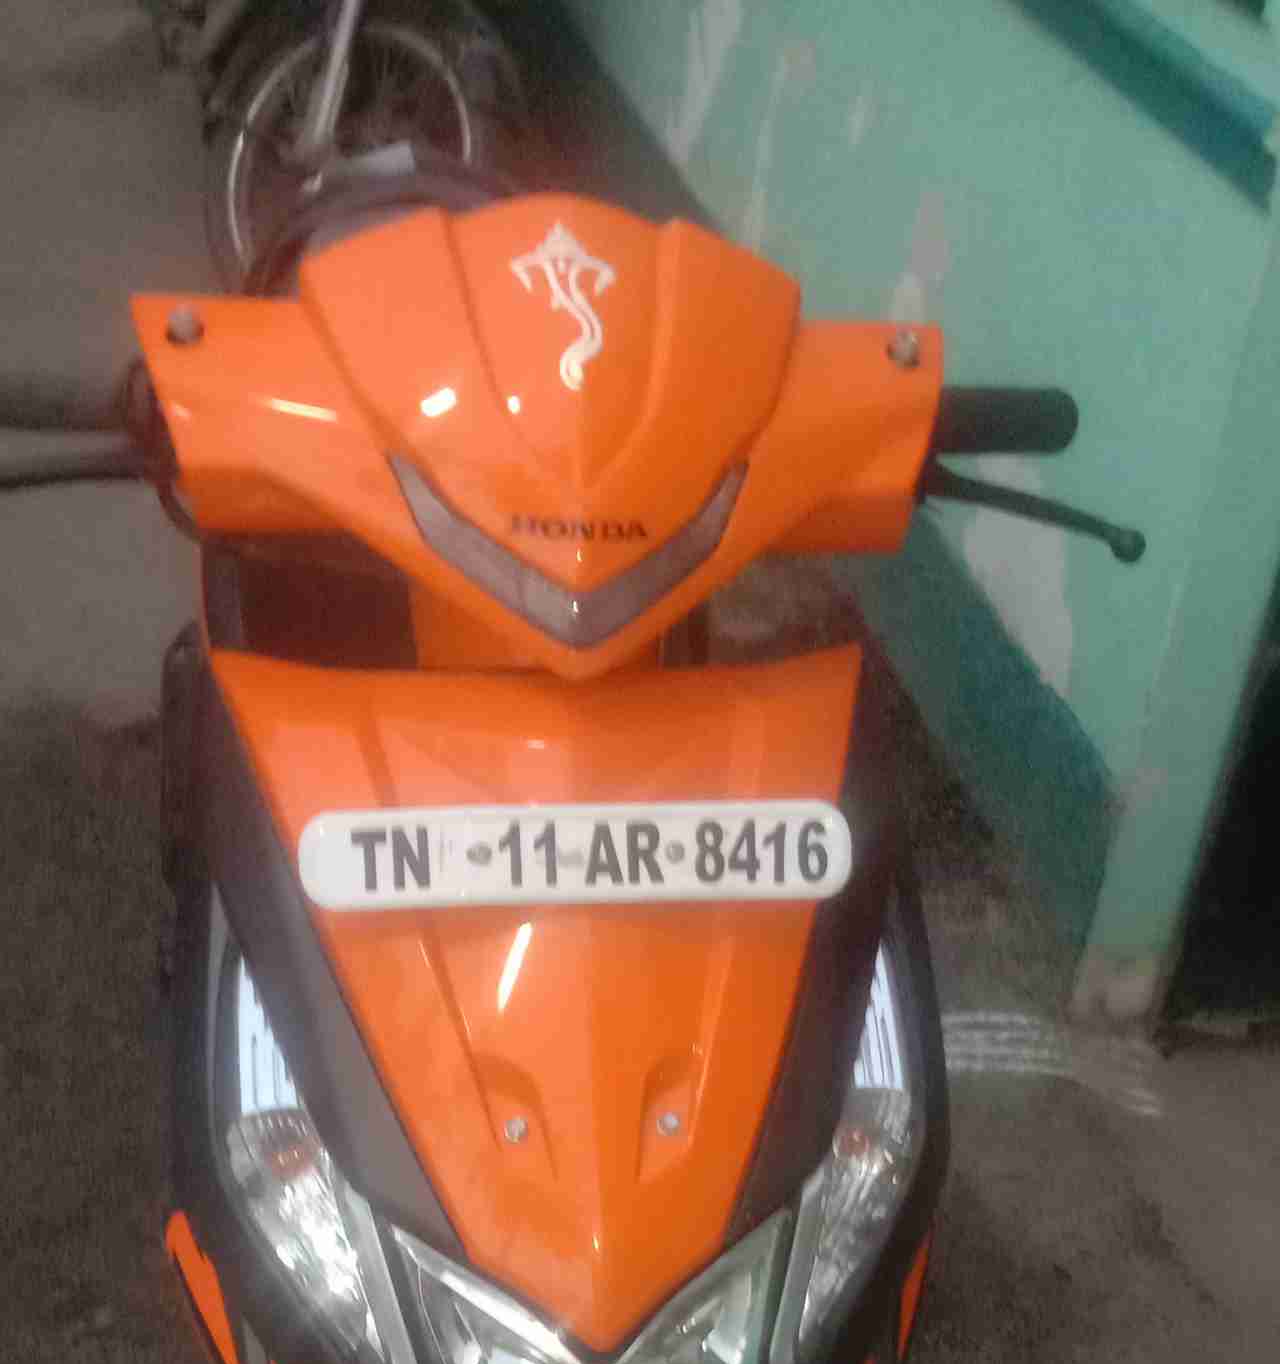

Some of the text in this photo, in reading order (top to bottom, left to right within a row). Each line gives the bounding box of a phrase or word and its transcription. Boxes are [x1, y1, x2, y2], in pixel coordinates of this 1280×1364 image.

[508, 512, 650, 542] HONDA
[350, 825, 432, 892] TN
[694, 819, 829, 885] 8416
